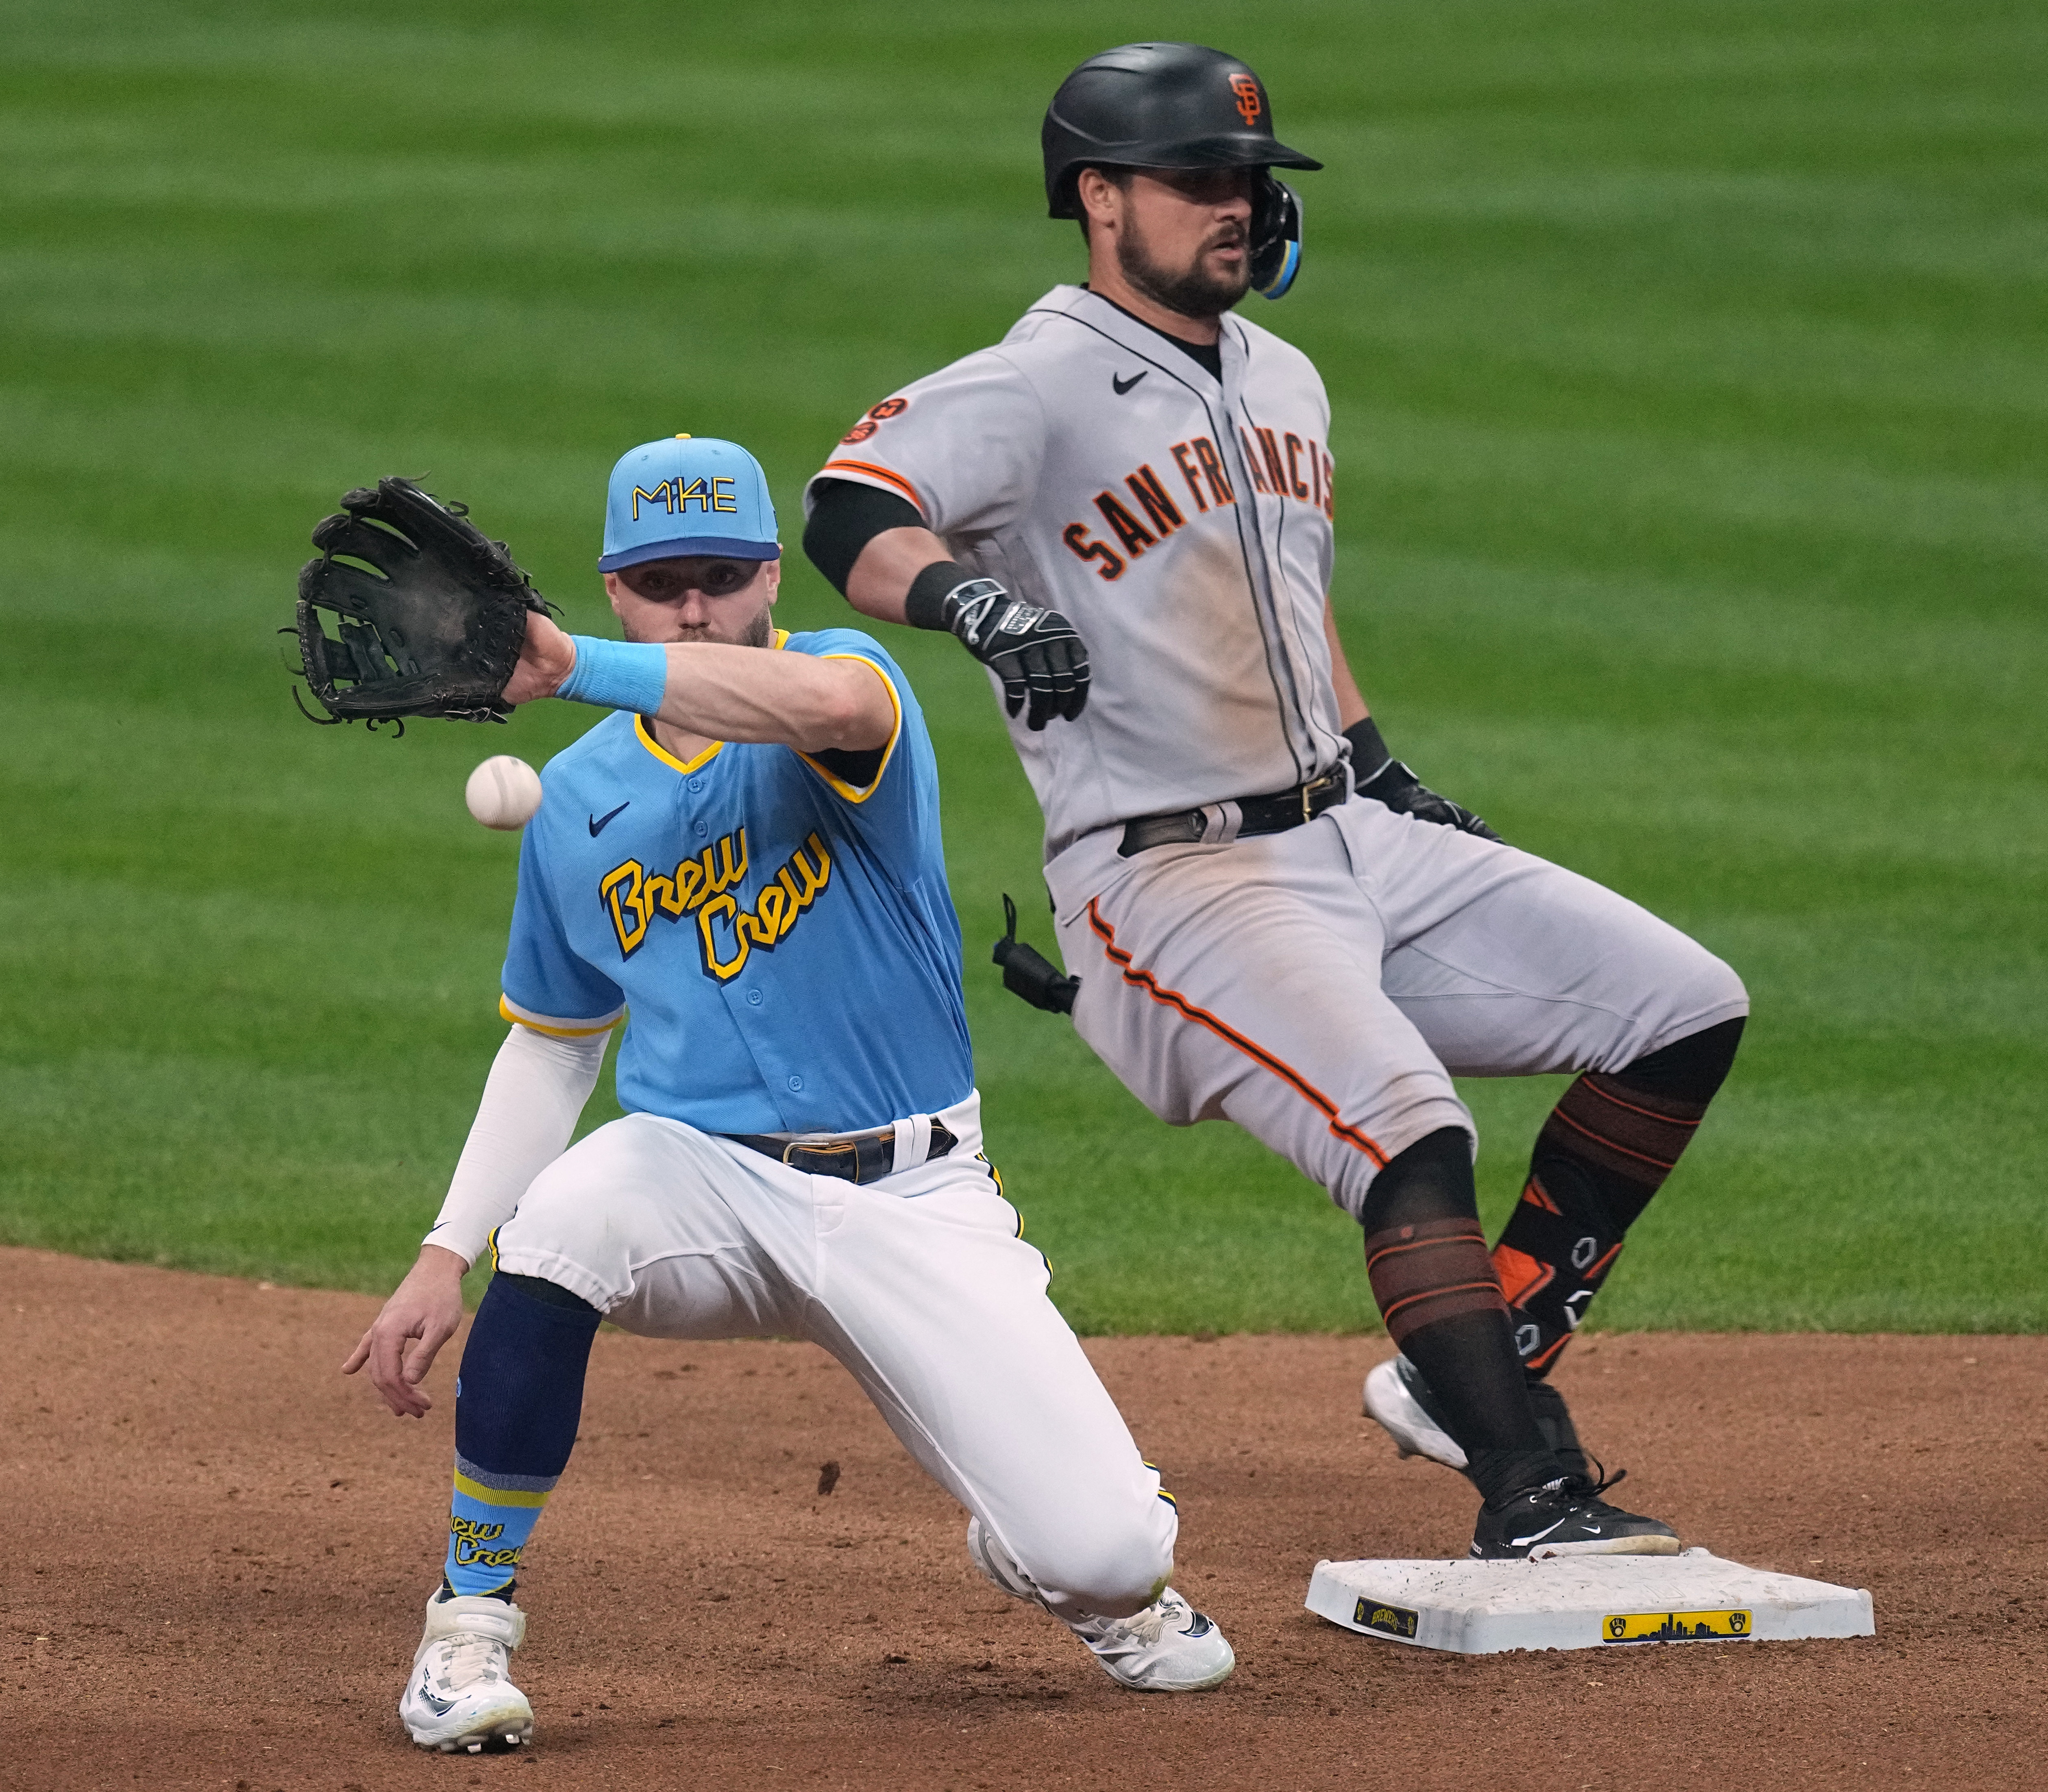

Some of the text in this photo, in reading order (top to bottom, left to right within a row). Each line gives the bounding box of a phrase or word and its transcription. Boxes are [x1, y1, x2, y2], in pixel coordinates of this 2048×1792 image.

[1228, 73, 1261, 125] SF
[632, 476, 738, 522] MKE
[1063, 463, 1188, 582] SAN
[598, 827, 749, 962] Brew
[695, 831, 832, 987] Crew
[1371, 1608, 1398, 1631] BREWERS
